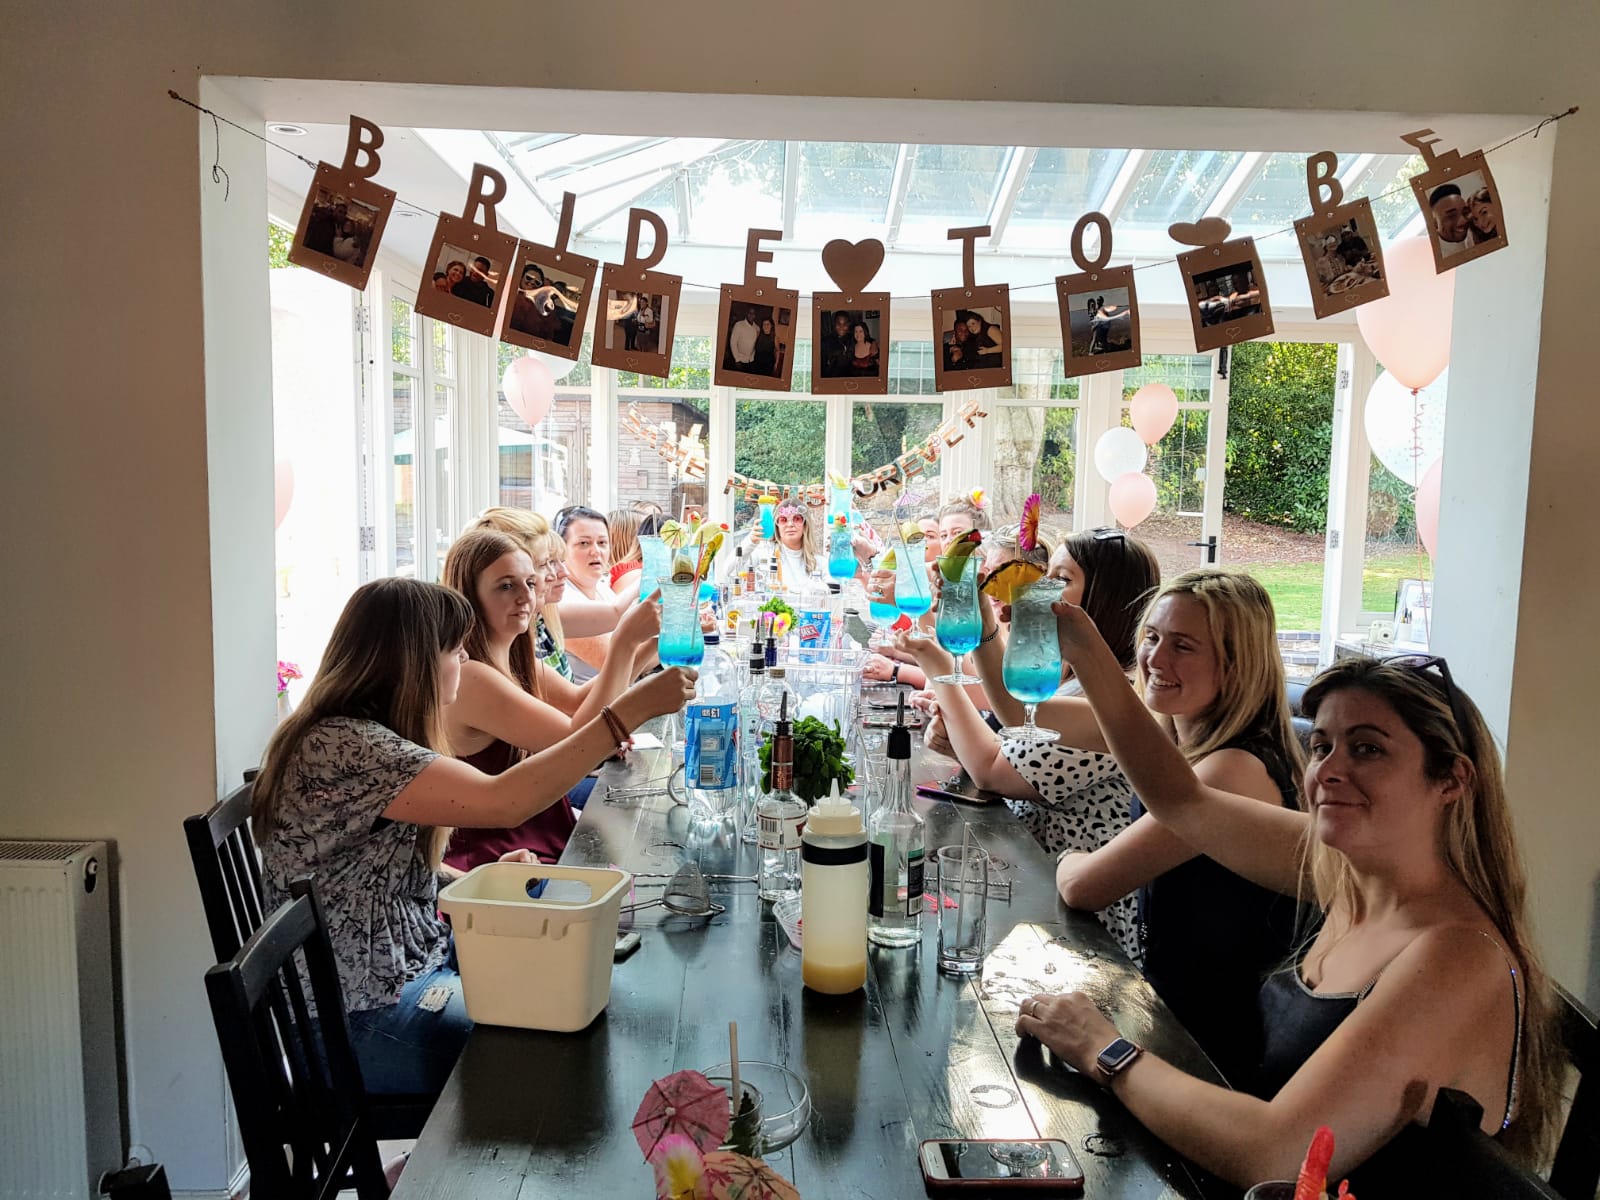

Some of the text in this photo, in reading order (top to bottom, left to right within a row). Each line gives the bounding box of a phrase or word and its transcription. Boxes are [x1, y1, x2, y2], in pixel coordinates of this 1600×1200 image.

[342, 114, 784, 288] BRIDE
[947, 211, 1112, 289] TO
[852, 399, 988, 498] OREVER
